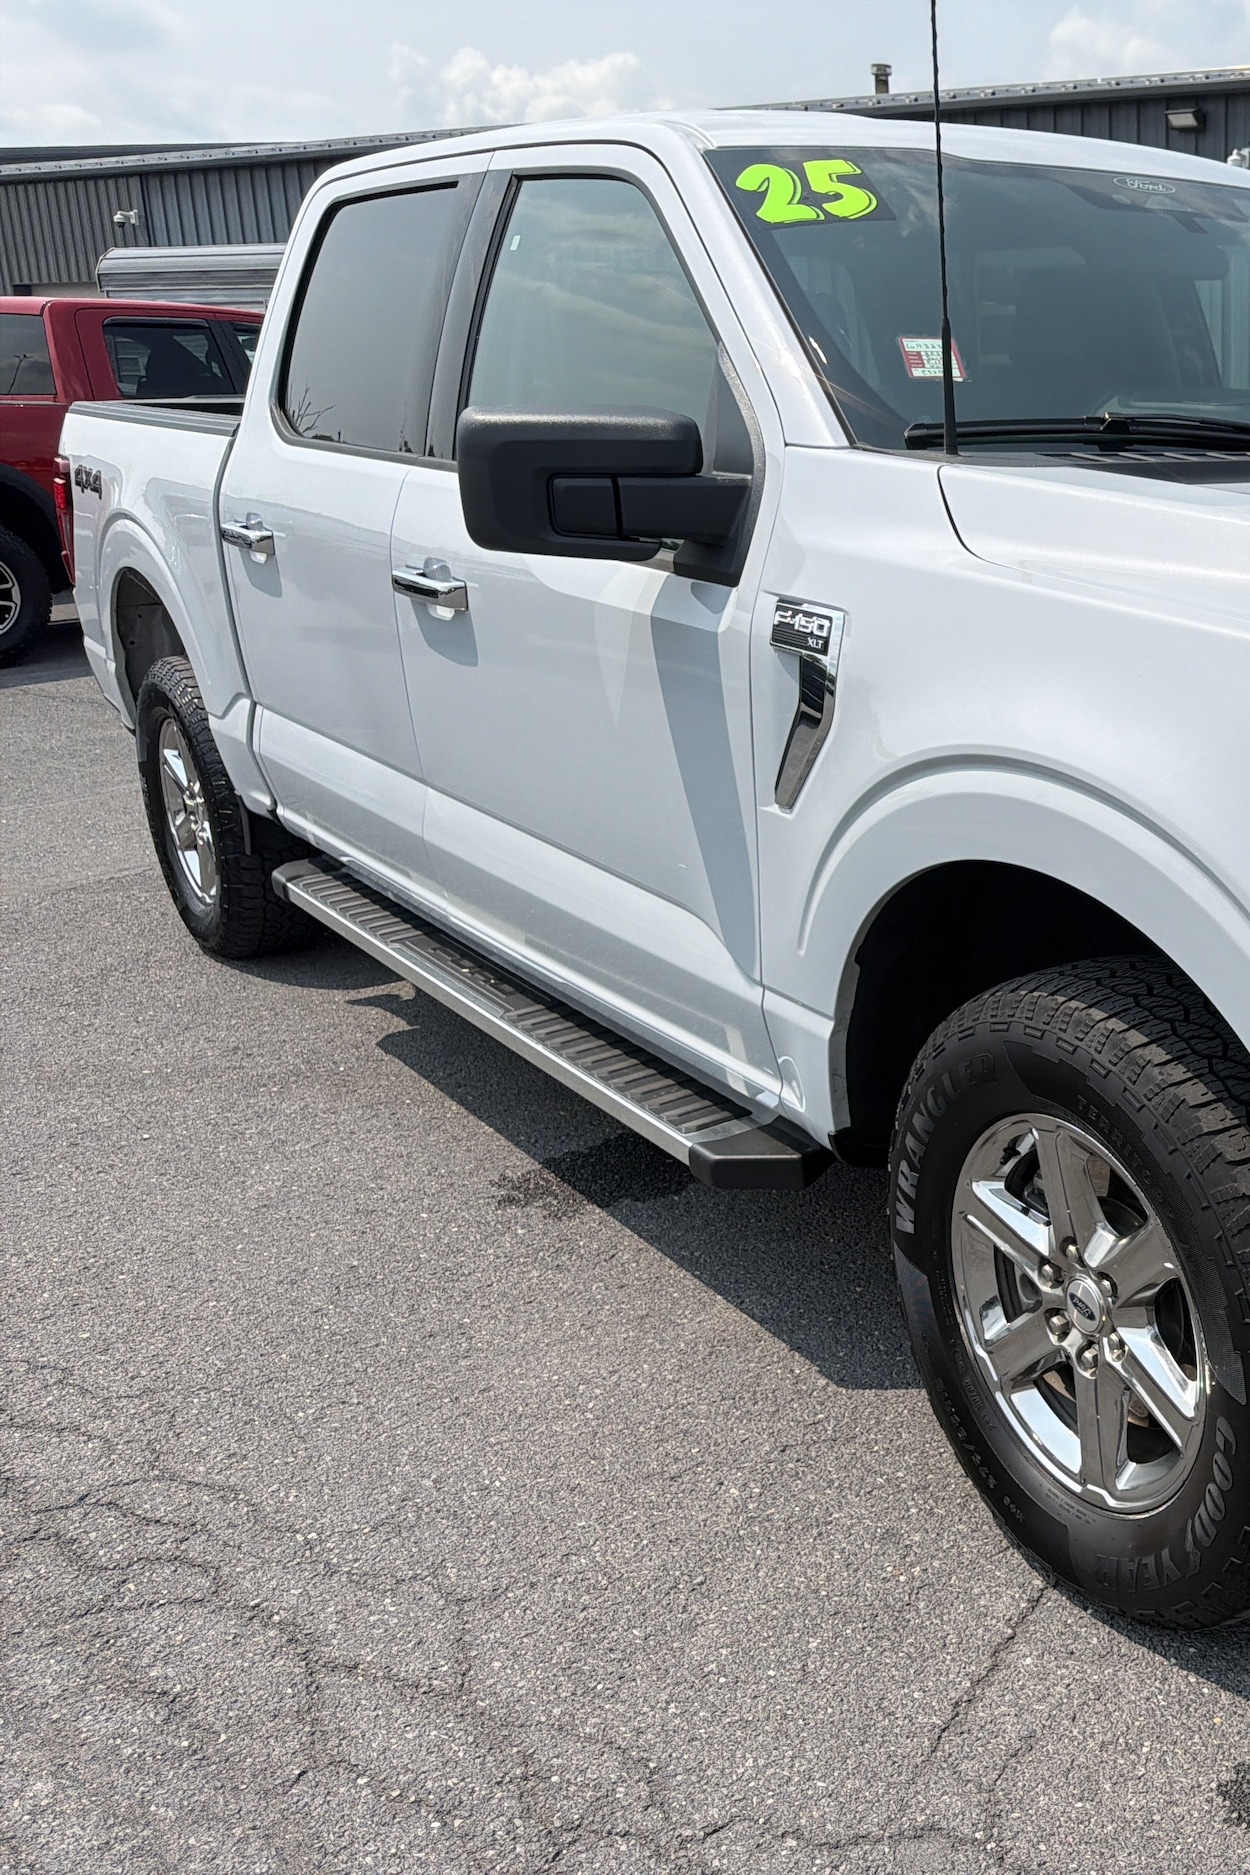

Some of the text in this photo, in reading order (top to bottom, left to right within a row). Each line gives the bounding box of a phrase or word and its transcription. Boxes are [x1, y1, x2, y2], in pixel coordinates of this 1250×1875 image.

[735, 159, 878, 224] 25
[1126, 179, 1166, 191] Ford
[773, 610, 831, 637] F-150
[807, 637, 824, 649] XLT
[895, 1052, 999, 1235] WRANGLER
[1096, 1415, 1237, 1592] GOODYEAR
